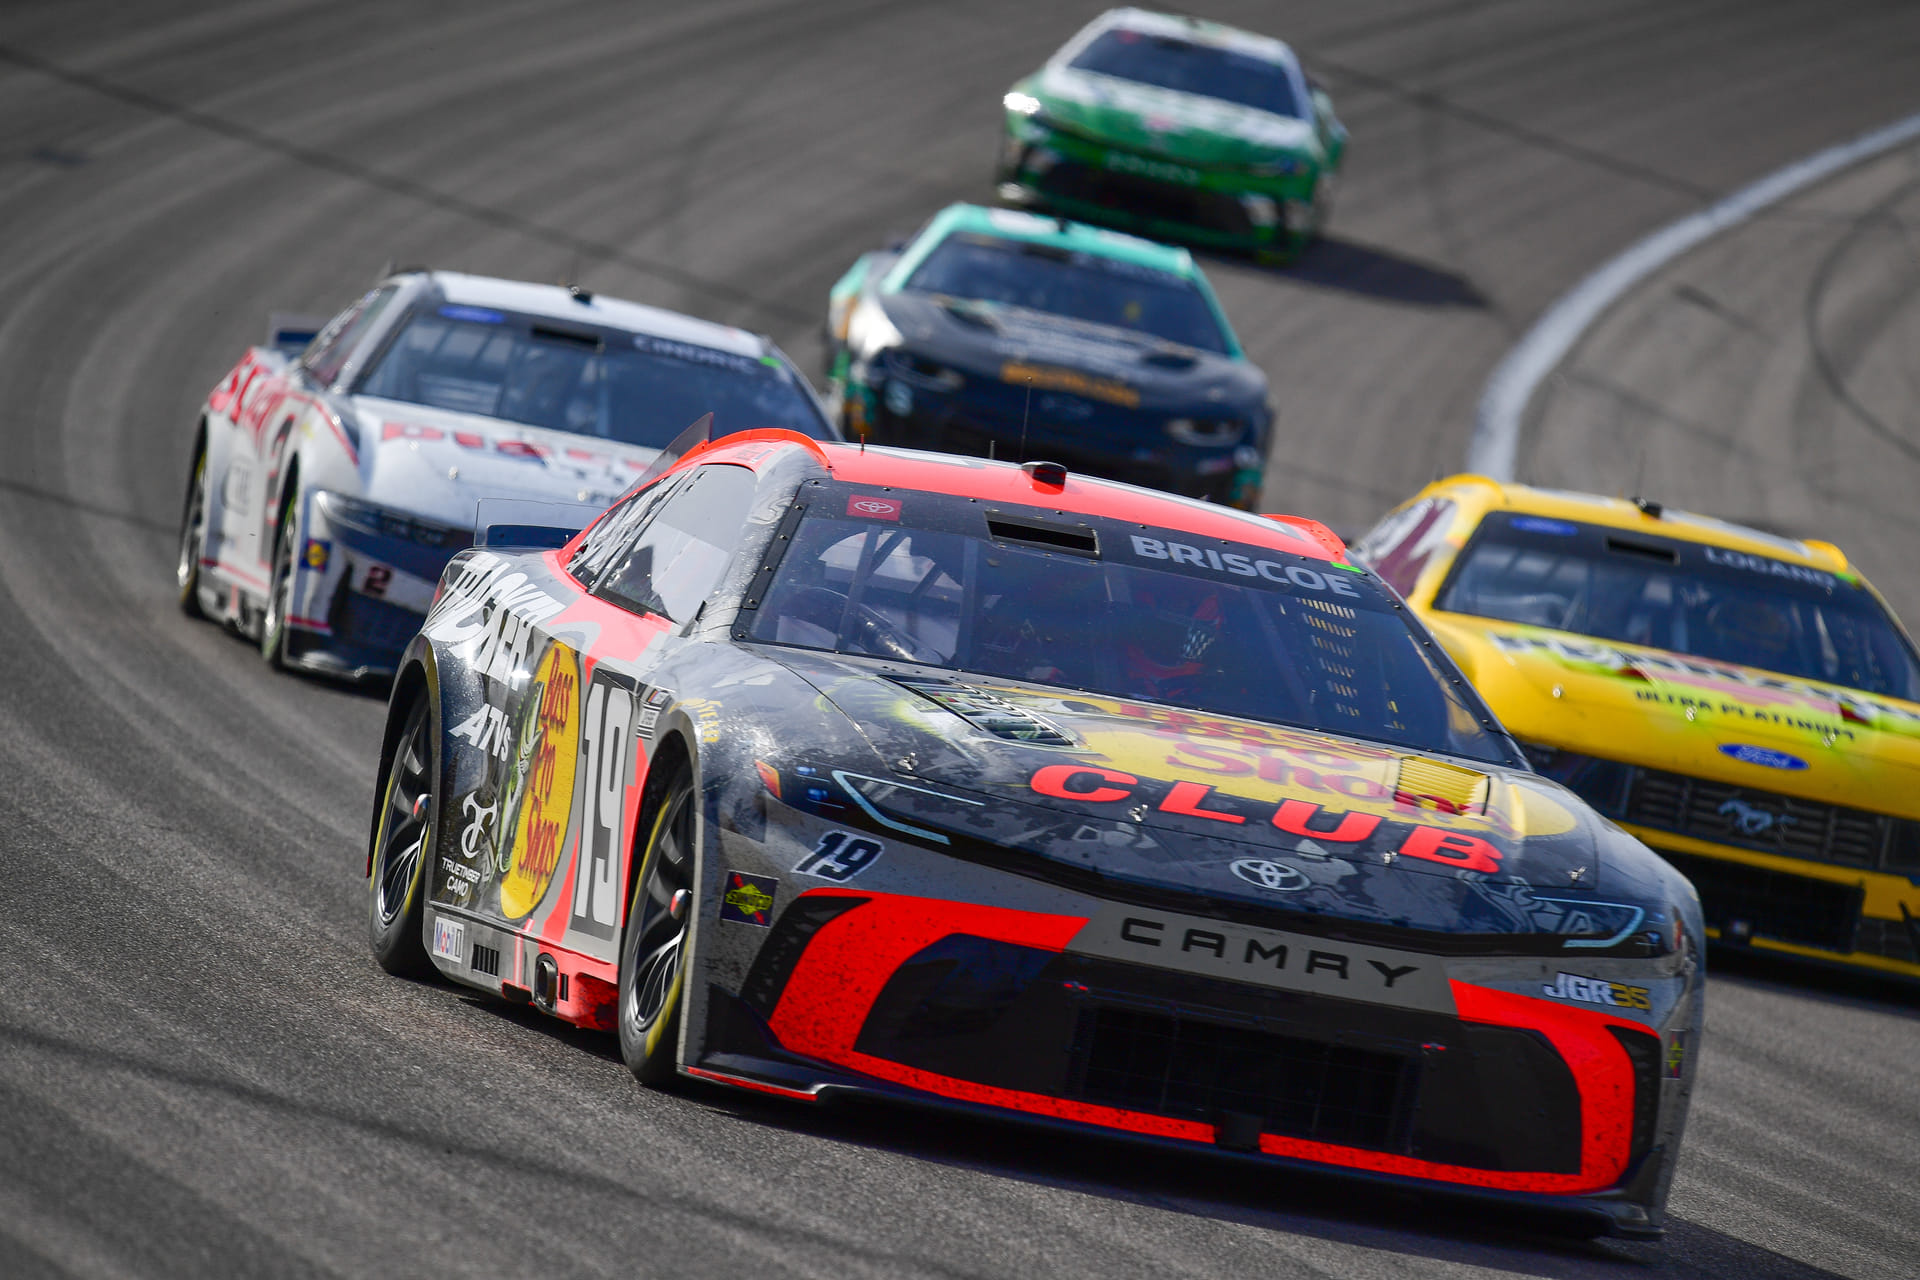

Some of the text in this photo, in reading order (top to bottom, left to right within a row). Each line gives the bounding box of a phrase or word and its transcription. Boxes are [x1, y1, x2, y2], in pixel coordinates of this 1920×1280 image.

[362, 566, 392, 595] 2
[1129, 534, 1361, 599] BRISCOE
[1703, 545, 1838, 590] LOGANO
[539, 646, 575, 728] Bass
[1636, 687, 1713, 716] ULTRA
[1117, 703, 1392, 759] Bass
[1735, 745, 1790, 768] Ford
[531, 722, 557, 802] Pro
[573, 682, 633, 928] 19
[1030, 764, 1504, 873] CLUB
[518, 794, 561, 899] Shops
[792, 830, 884, 883] 19
[446, 876, 469, 897] CAMO
[1120, 917, 1421, 988] CAMRY
